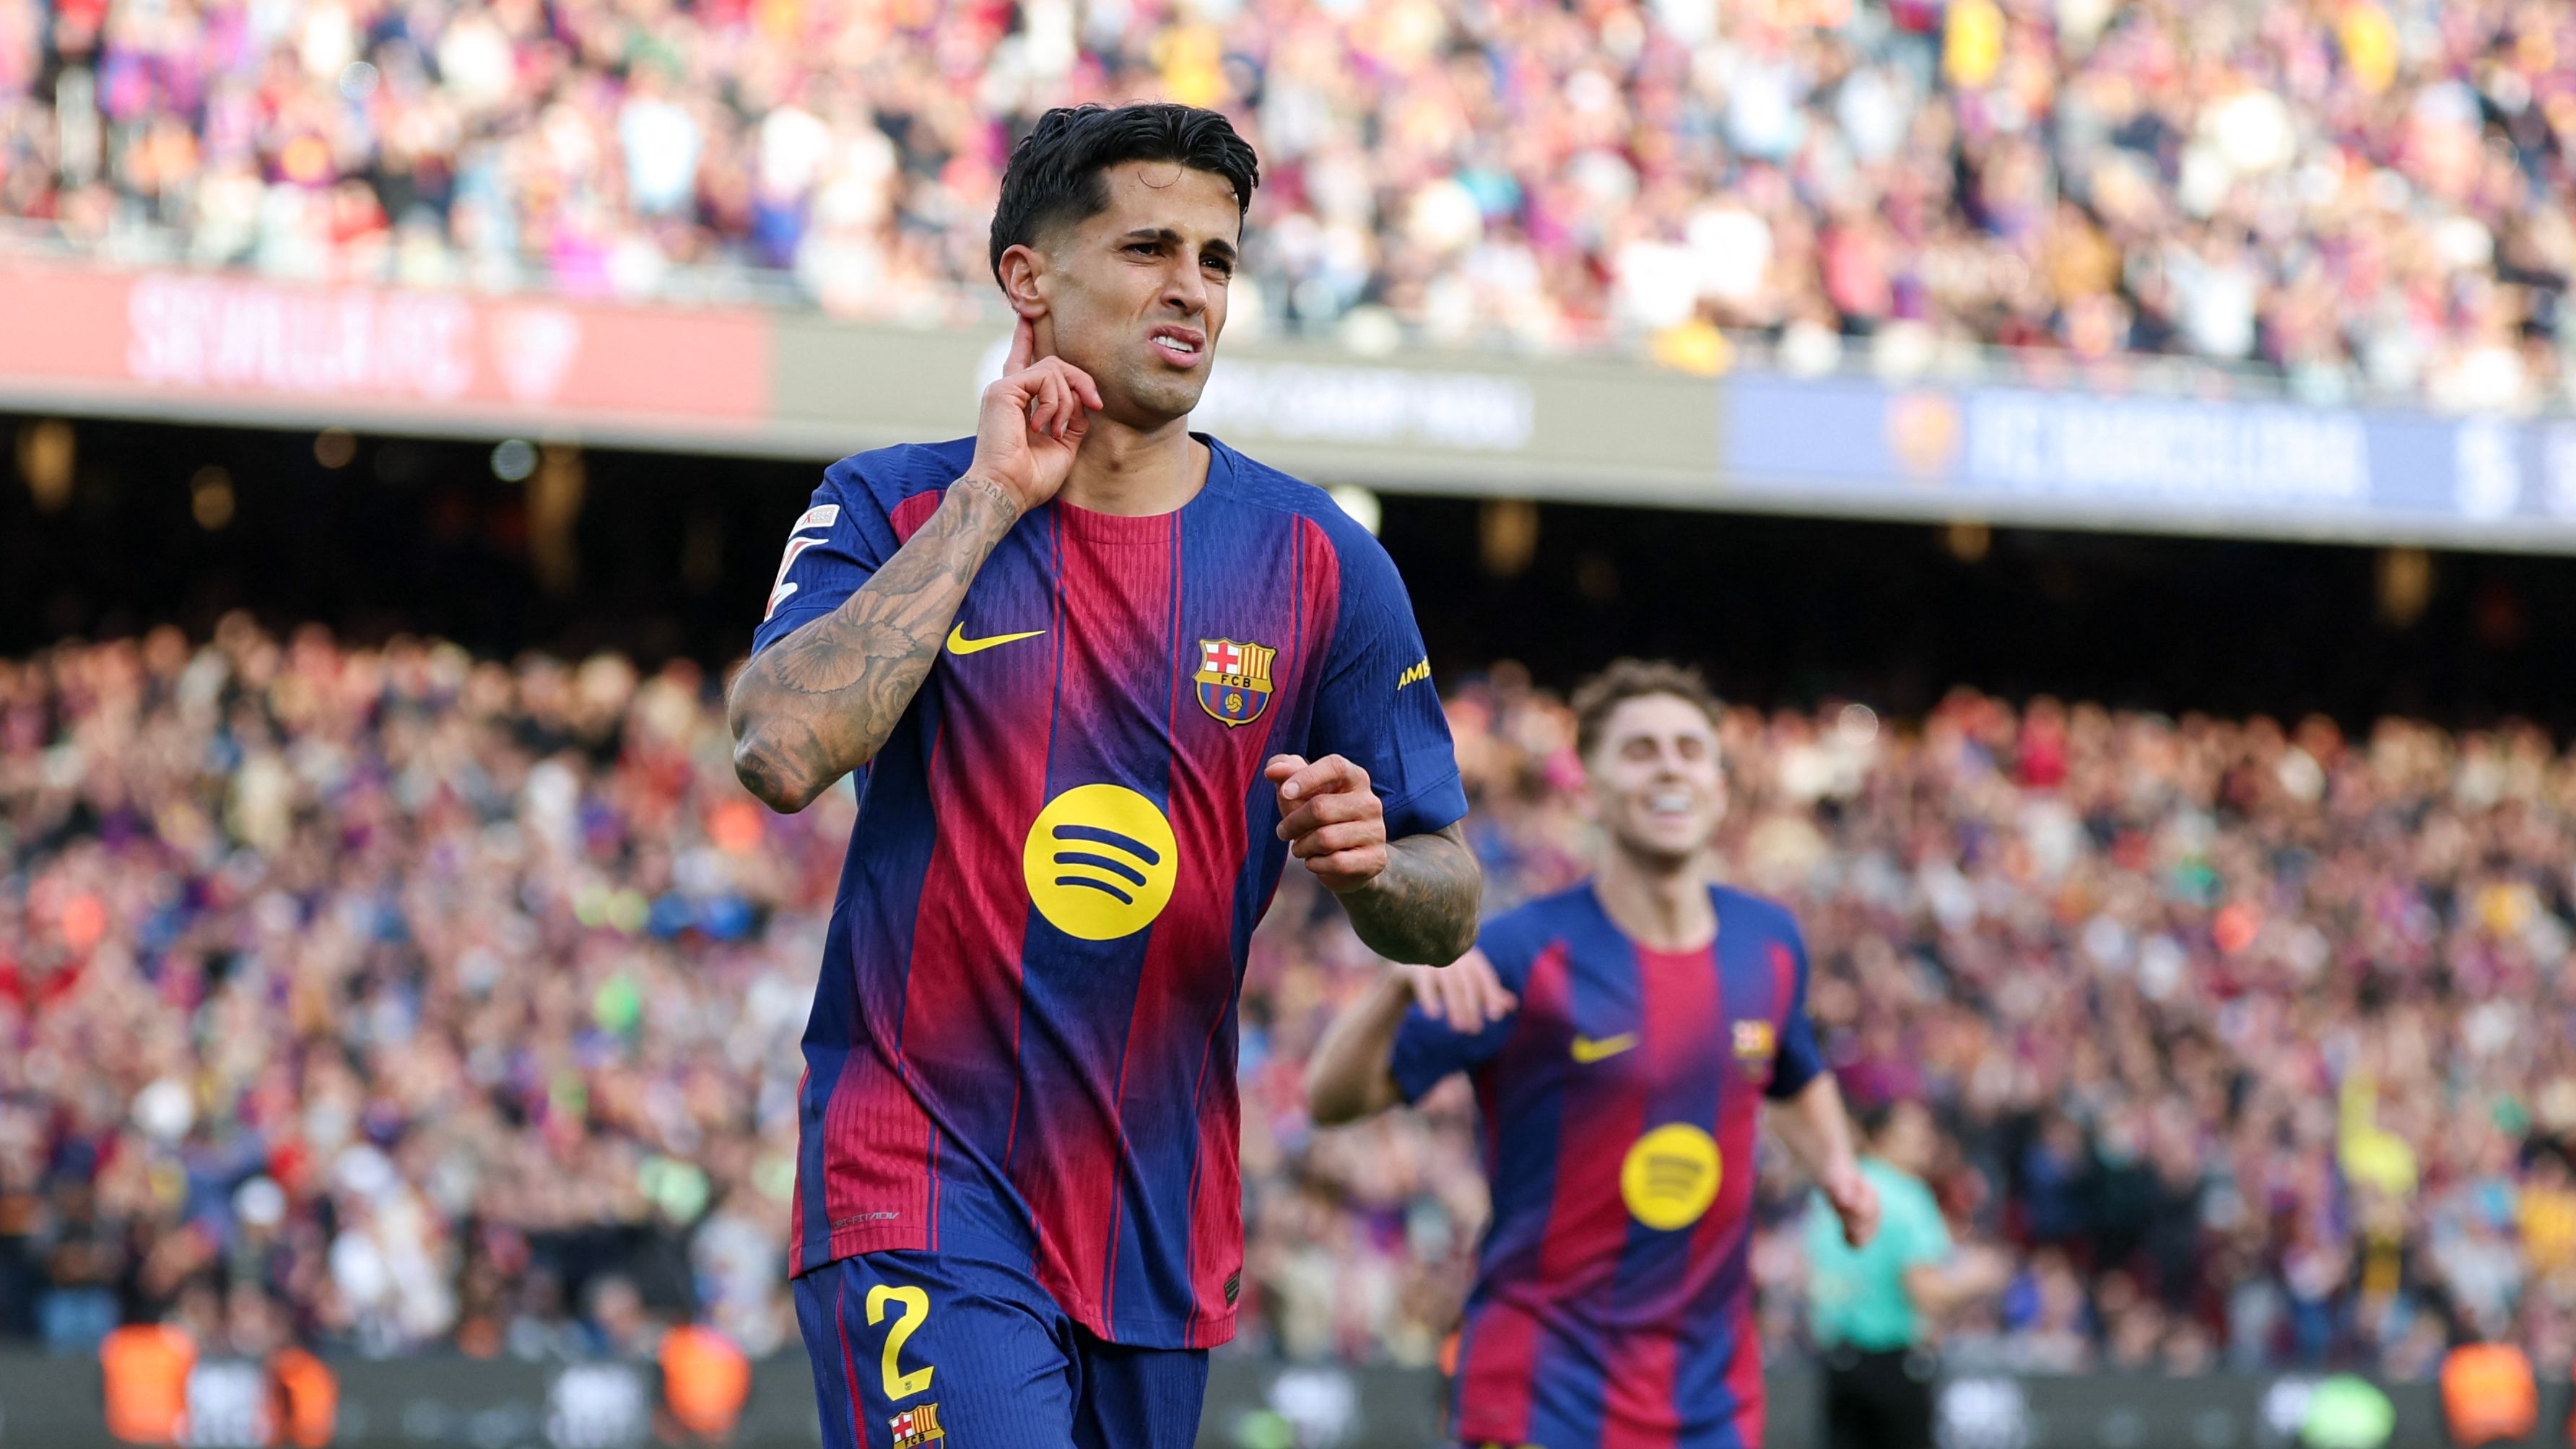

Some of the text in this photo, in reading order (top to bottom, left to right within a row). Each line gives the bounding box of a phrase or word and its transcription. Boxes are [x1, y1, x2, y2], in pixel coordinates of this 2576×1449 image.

[1221, 675, 1250, 688] FCB
[866, 1284, 934, 1402] 2
[905, 1433, 926, 1448] FCB
